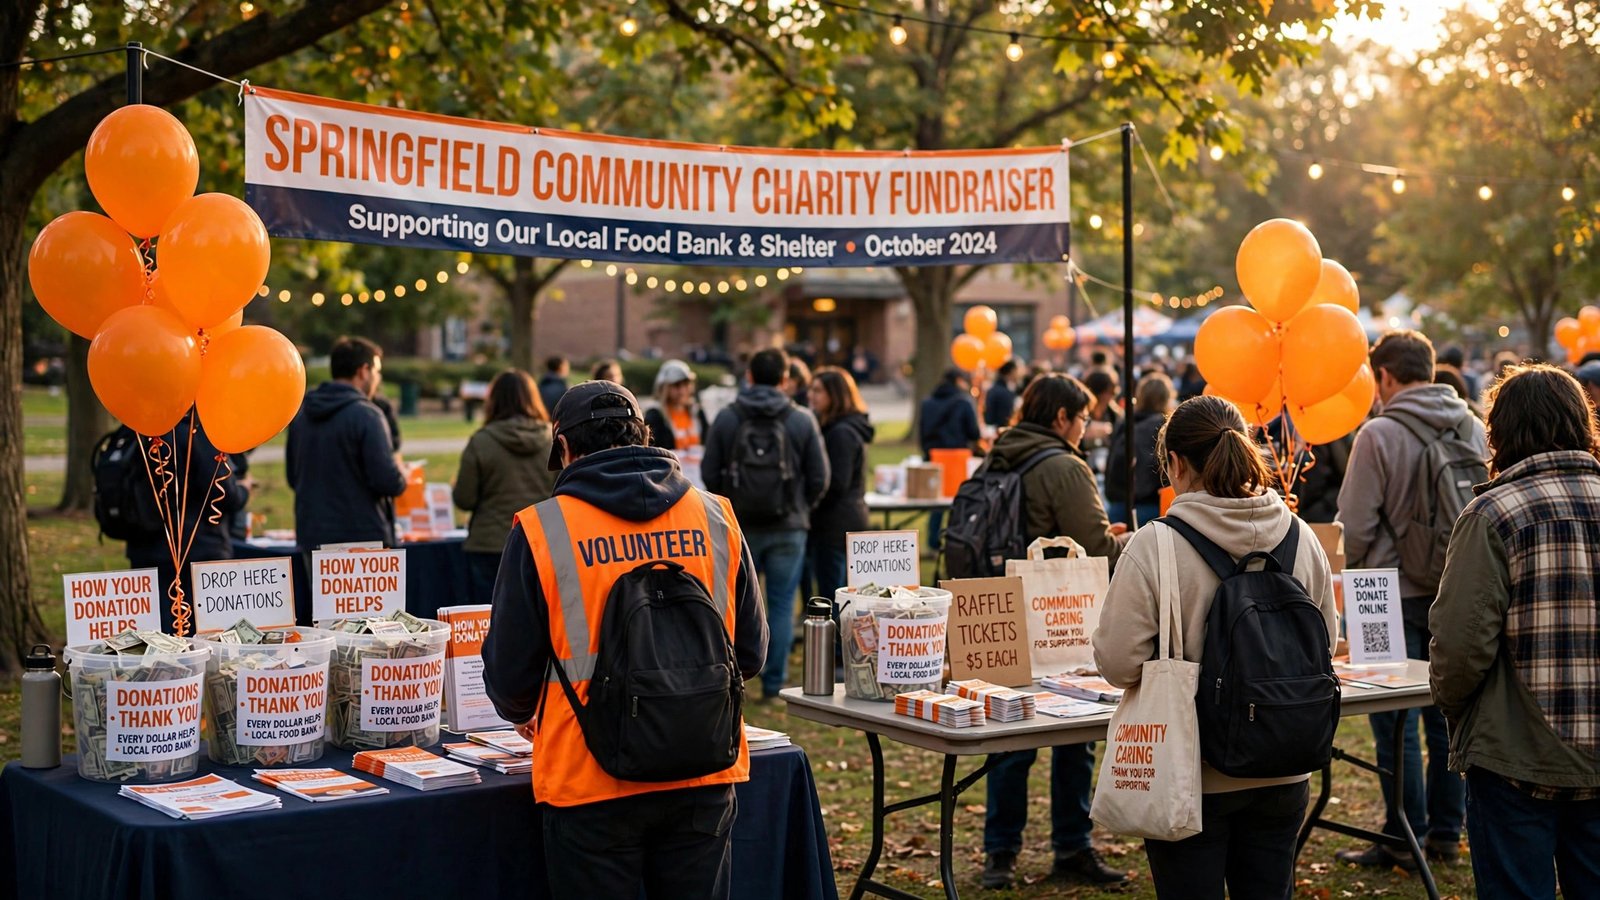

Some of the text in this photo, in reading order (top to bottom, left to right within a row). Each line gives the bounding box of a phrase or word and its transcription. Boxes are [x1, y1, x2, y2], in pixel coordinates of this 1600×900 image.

[265, 114, 1055, 216] SPRINGFIELD COMMUNITY CHARITY FUNDRAISER
[348, 204, 997, 258] Supporting Our Local Food Bank & Shelter October 2024
[578, 529, 707, 568] VOLUNTEER
[852, 539, 908, 555] DROP HERE
[319, 556, 400, 575] HOW YOUR
[856, 558, 912, 574] DONATIONS
[72, 576, 152, 598] HOW YOUR
[201, 568, 278, 589] DROP HERE
[321, 576, 398, 595] DONATION
[1353, 577, 1388, 588] SCAN TO
[206, 591, 284, 613] DONATIONS
[1032, 594, 1094, 611] COMMUNITY
[1356, 590, 1388, 601] DONATE
[74, 597, 151, 620] DONATION
[336, 595, 383, 614] HELPS
[957, 592, 1015, 617] RAFFLE
[1358, 603, 1388, 615] ONLINE
[454, 620, 475, 632] HOW
[1045, 611, 1083, 626] CARING
[454, 630, 489, 643] DONAT
[887, 622, 945, 640] DONATIONS
[957, 621, 1017, 646] TICKETS
[1046, 628, 1083, 638] THANK YOU
[888, 642, 929, 656] THANK
[1034, 637, 1090, 648] FOR SUPPORTING
[887, 661, 907, 670] EVERY
[909, 660, 931, 670] DOLLAR
[987, 649, 1018, 668] EACH
[371, 659, 442, 681] DONATIONS
[912, 670, 928, 678] FOOD
[246, 671, 324, 694] DONATIONS
[372, 683, 420, 700] THANK
[424, 678, 441, 697] YOU
[117, 683, 199, 707] DONATIONS
[248, 690, 324, 714] THANK YOU
[119, 703, 198, 728] THANK YOU
[371, 706, 395, 715] EVERY
[396, 704, 423, 715] DOLLAR
[247, 713, 321, 729] EVERY DOLLAR HELPS
[375, 711, 436, 726] LOCAL FOOD BANK
[117, 727, 195, 744] EVERY DOLLAR HELPS
[251, 724, 318, 739] LOCAL FOOD BANK
[122, 741, 192, 755] LOCAL FOOD BANK
[1115, 745, 1153, 765] CARING
[1111, 766, 1155, 778] THANK YOU FOR
[1114, 780, 1150, 791] SUPPORTING
